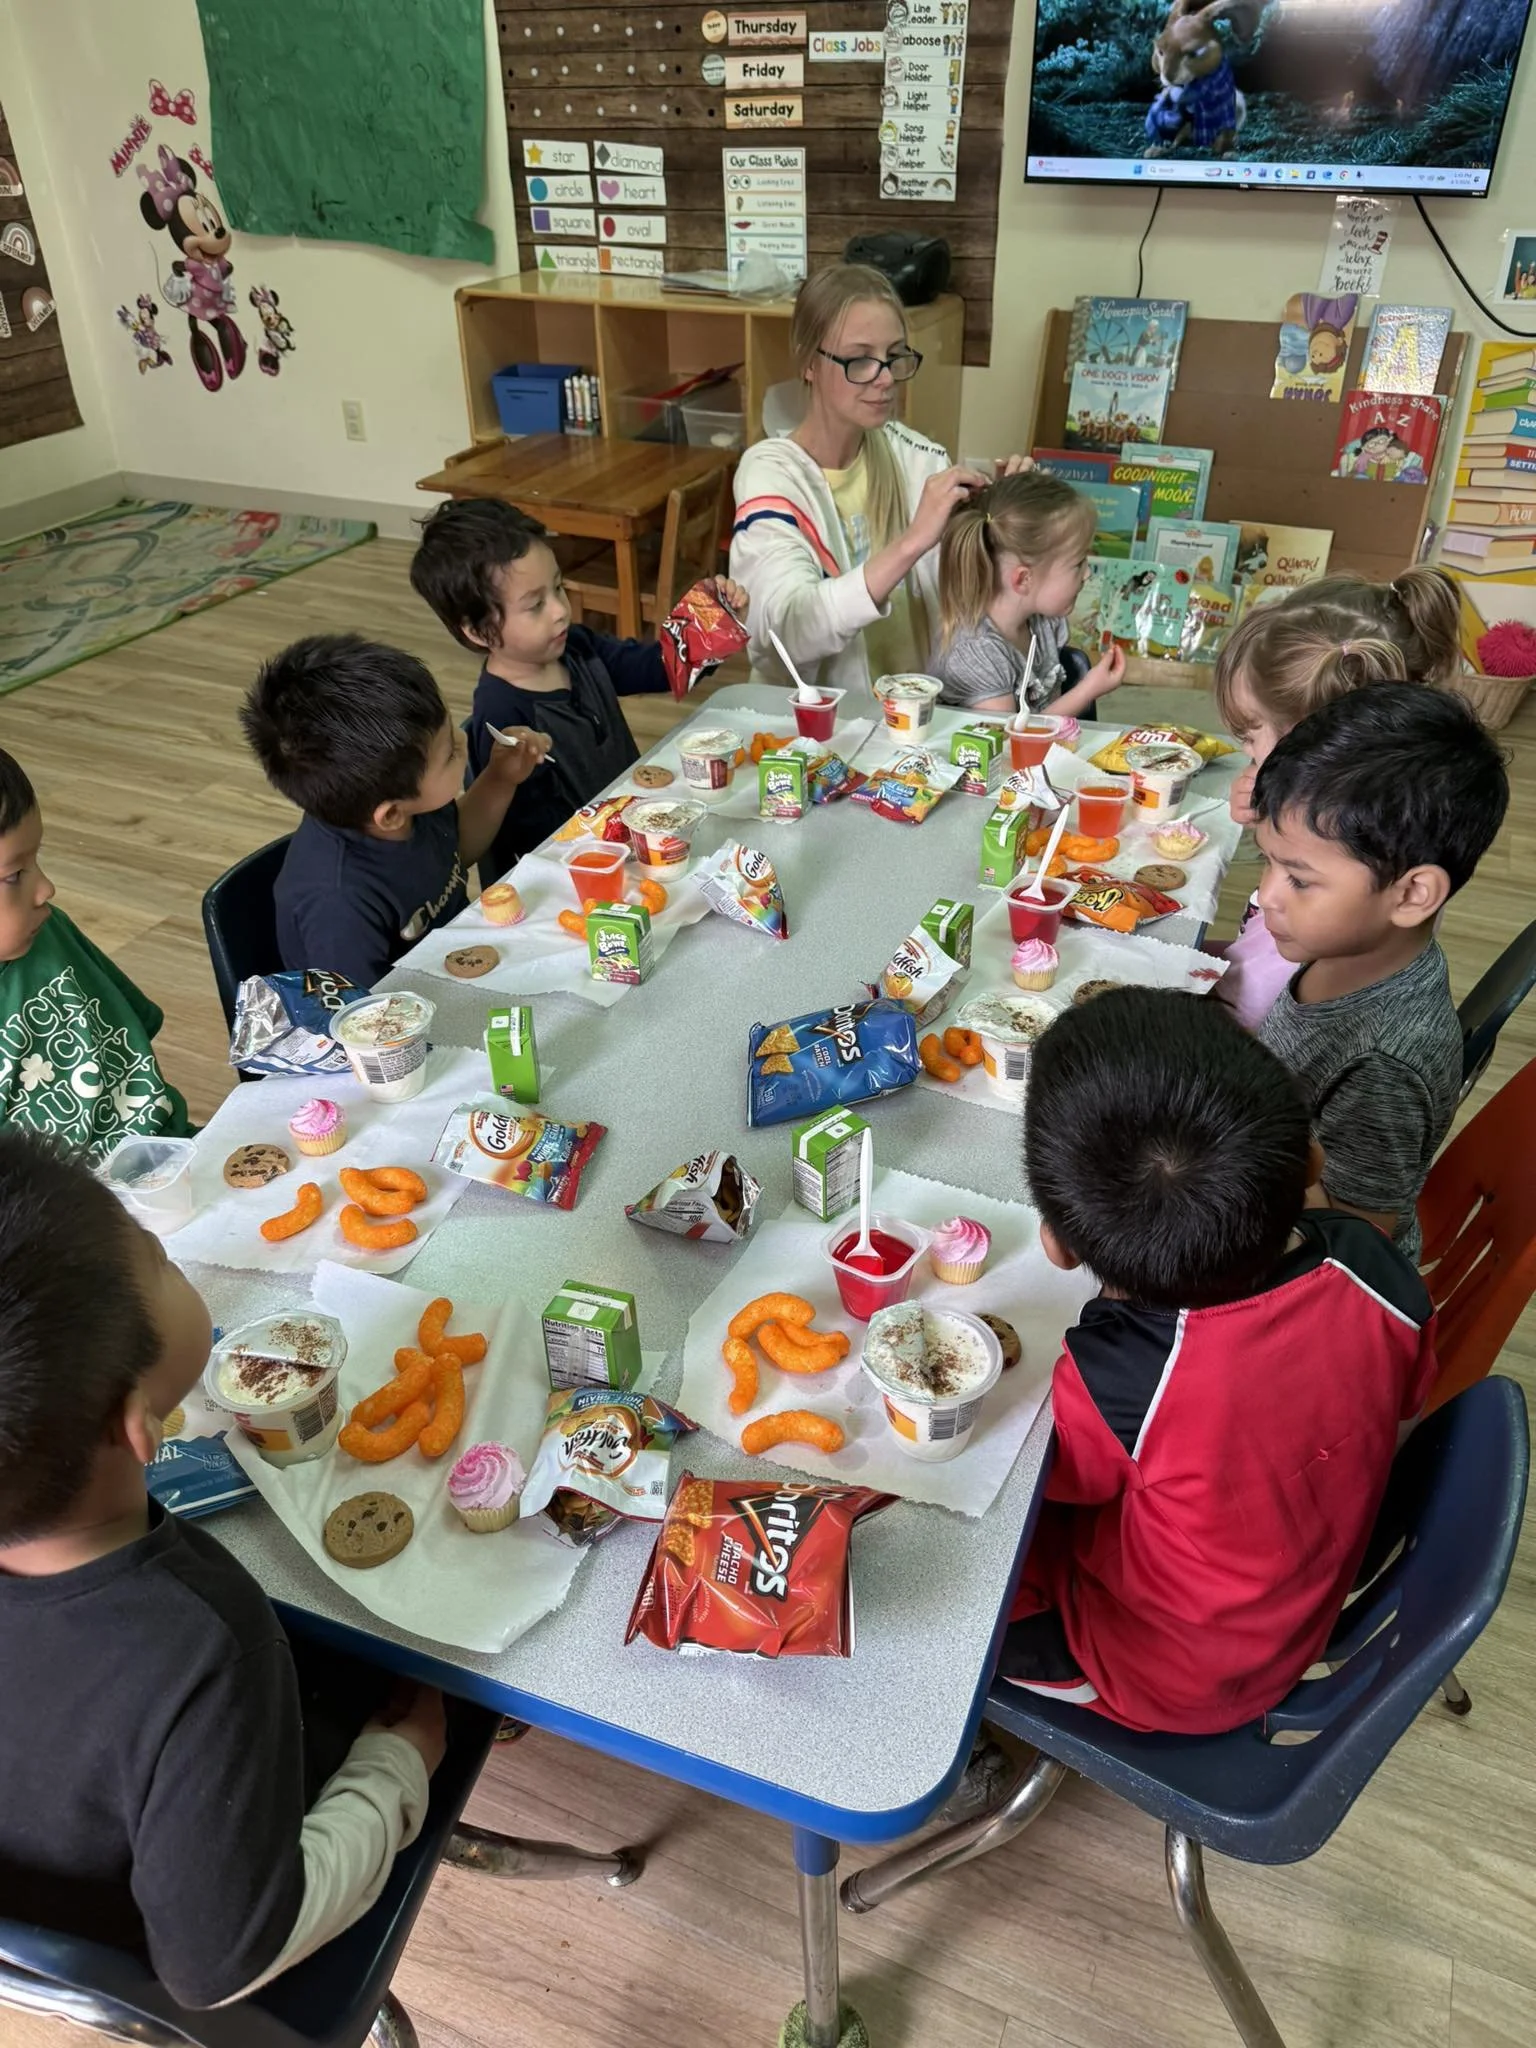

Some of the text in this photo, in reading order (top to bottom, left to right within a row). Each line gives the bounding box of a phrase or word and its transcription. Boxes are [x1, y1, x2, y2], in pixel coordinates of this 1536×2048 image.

[914, 3, 931, 13] Line
[734, 19, 797, 35] Thursday
[908, 15, 938, 24] eader
[813, 37, 881, 53] Class Jobs
[902, 33, 942, 46] aboose
[742, 62, 785, 79] Friday
[909, 62, 929, 72] Door
[904, 73, 933, 82] Holder
[907, 91, 928, 104] Light
[734, 103, 795, 118] Saturday
[902, 101, 931, 111] Helper
[904, 122, 925, 134] Song
[109, 118, 152, 178] MINNIE
[906, 148, 920, 156] Art
[552, 150, 576, 164] star
[611, 152, 662, 173] diamond
[730, 154, 799, 168] Our Class Rules
[555, 179, 585, 197] circle
[624, 182, 656, 200] heart
[900, 179, 928, 188] eather
[553, 216, 592, 234] square
[627, 219, 652, 238] oval
[556, 250, 597, 273] triangle
[612, 251, 664, 275] rectangle
[1349, 392, 1404, 414] Kindness
[1410, 397, 1440, 422] Share
[1374, 410, 1412, 427] A Z
[1112, 466, 1189, 485] GOODNIGHT
[1152, 487, 1194, 504] MOON
[599, 930, 627, 942] JUICE
[598, 940, 627, 953] BOWL
[833, 1002, 863, 1064] Doritos
[819, 1045, 832, 1067] COOL
[544, 1318, 580, 1332] Nutrition
[716, 1534, 736, 1584] CHEESE
[727, 1541, 744, 1586] NACHO
